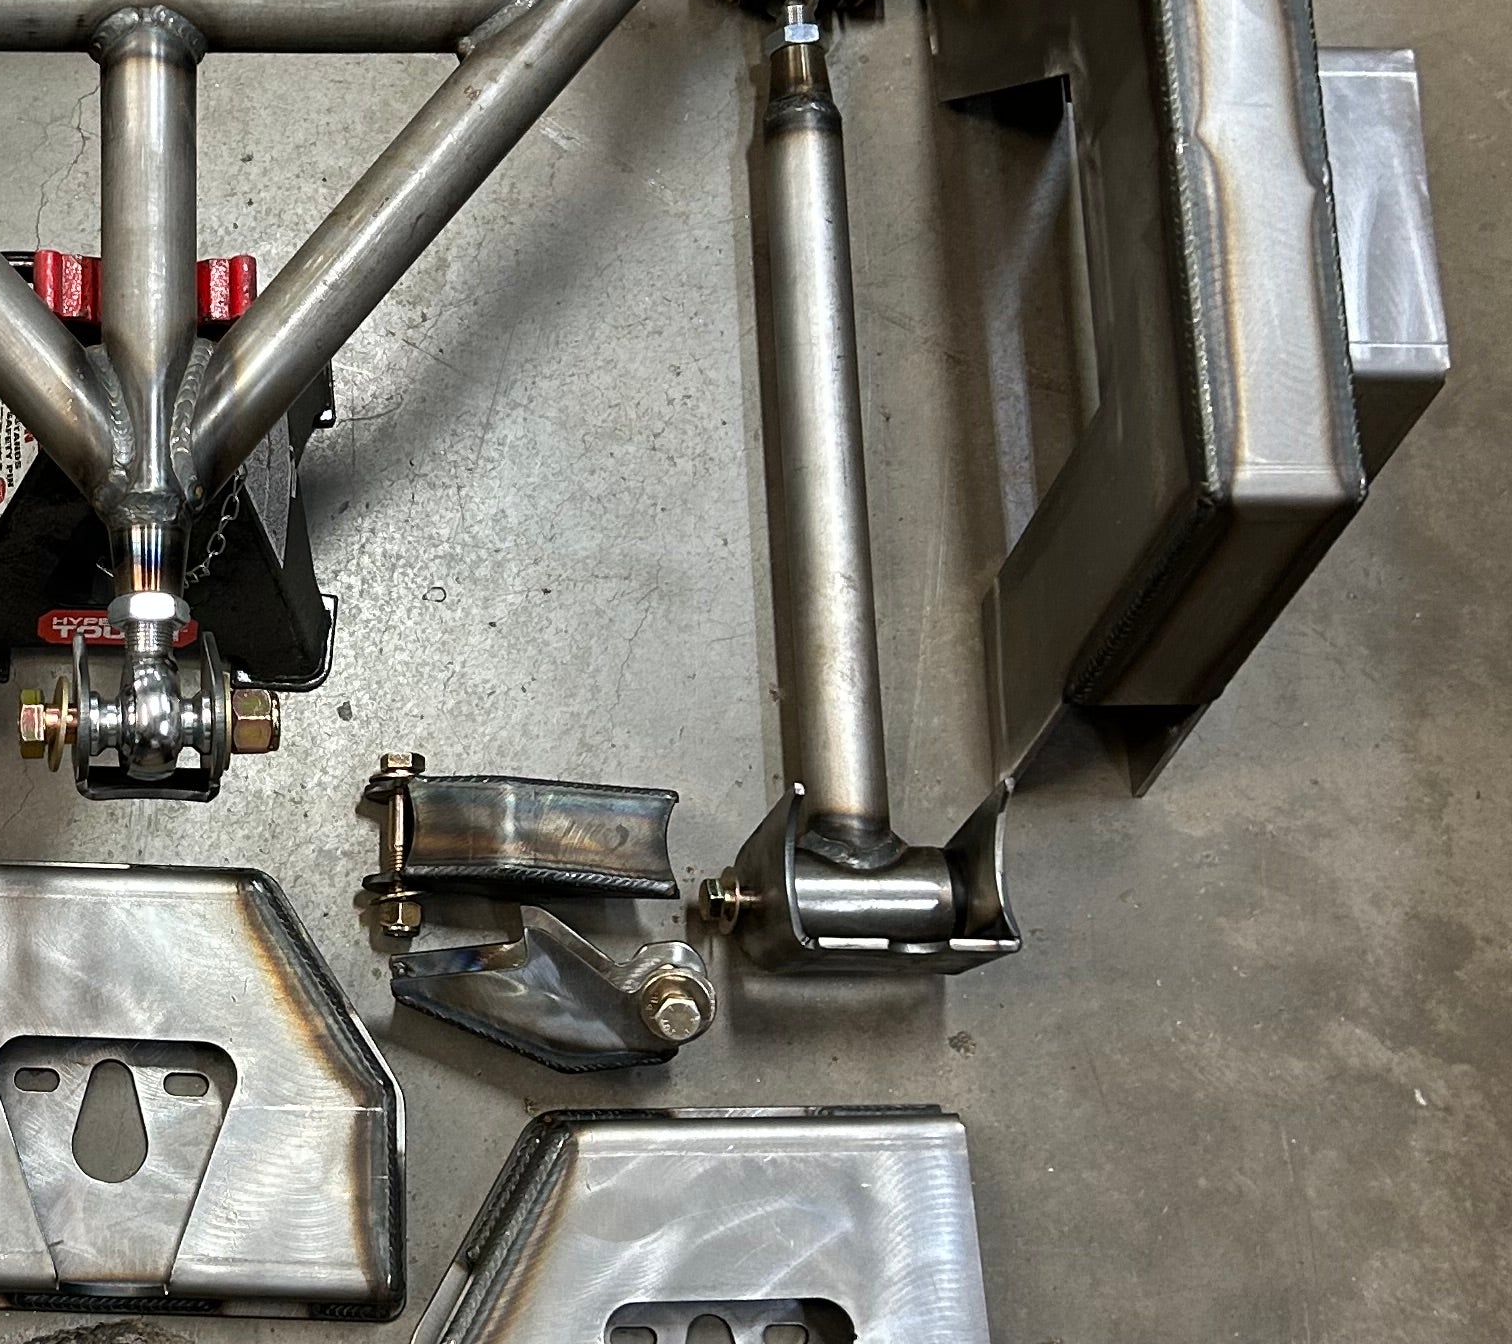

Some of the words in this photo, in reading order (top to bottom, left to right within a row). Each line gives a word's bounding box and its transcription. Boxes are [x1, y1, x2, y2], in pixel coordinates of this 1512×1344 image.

[5, 412, 14, 460] SAFETY
[6, 464, 15, 488] PIN
[52, 617, 109, 626] HYPE
